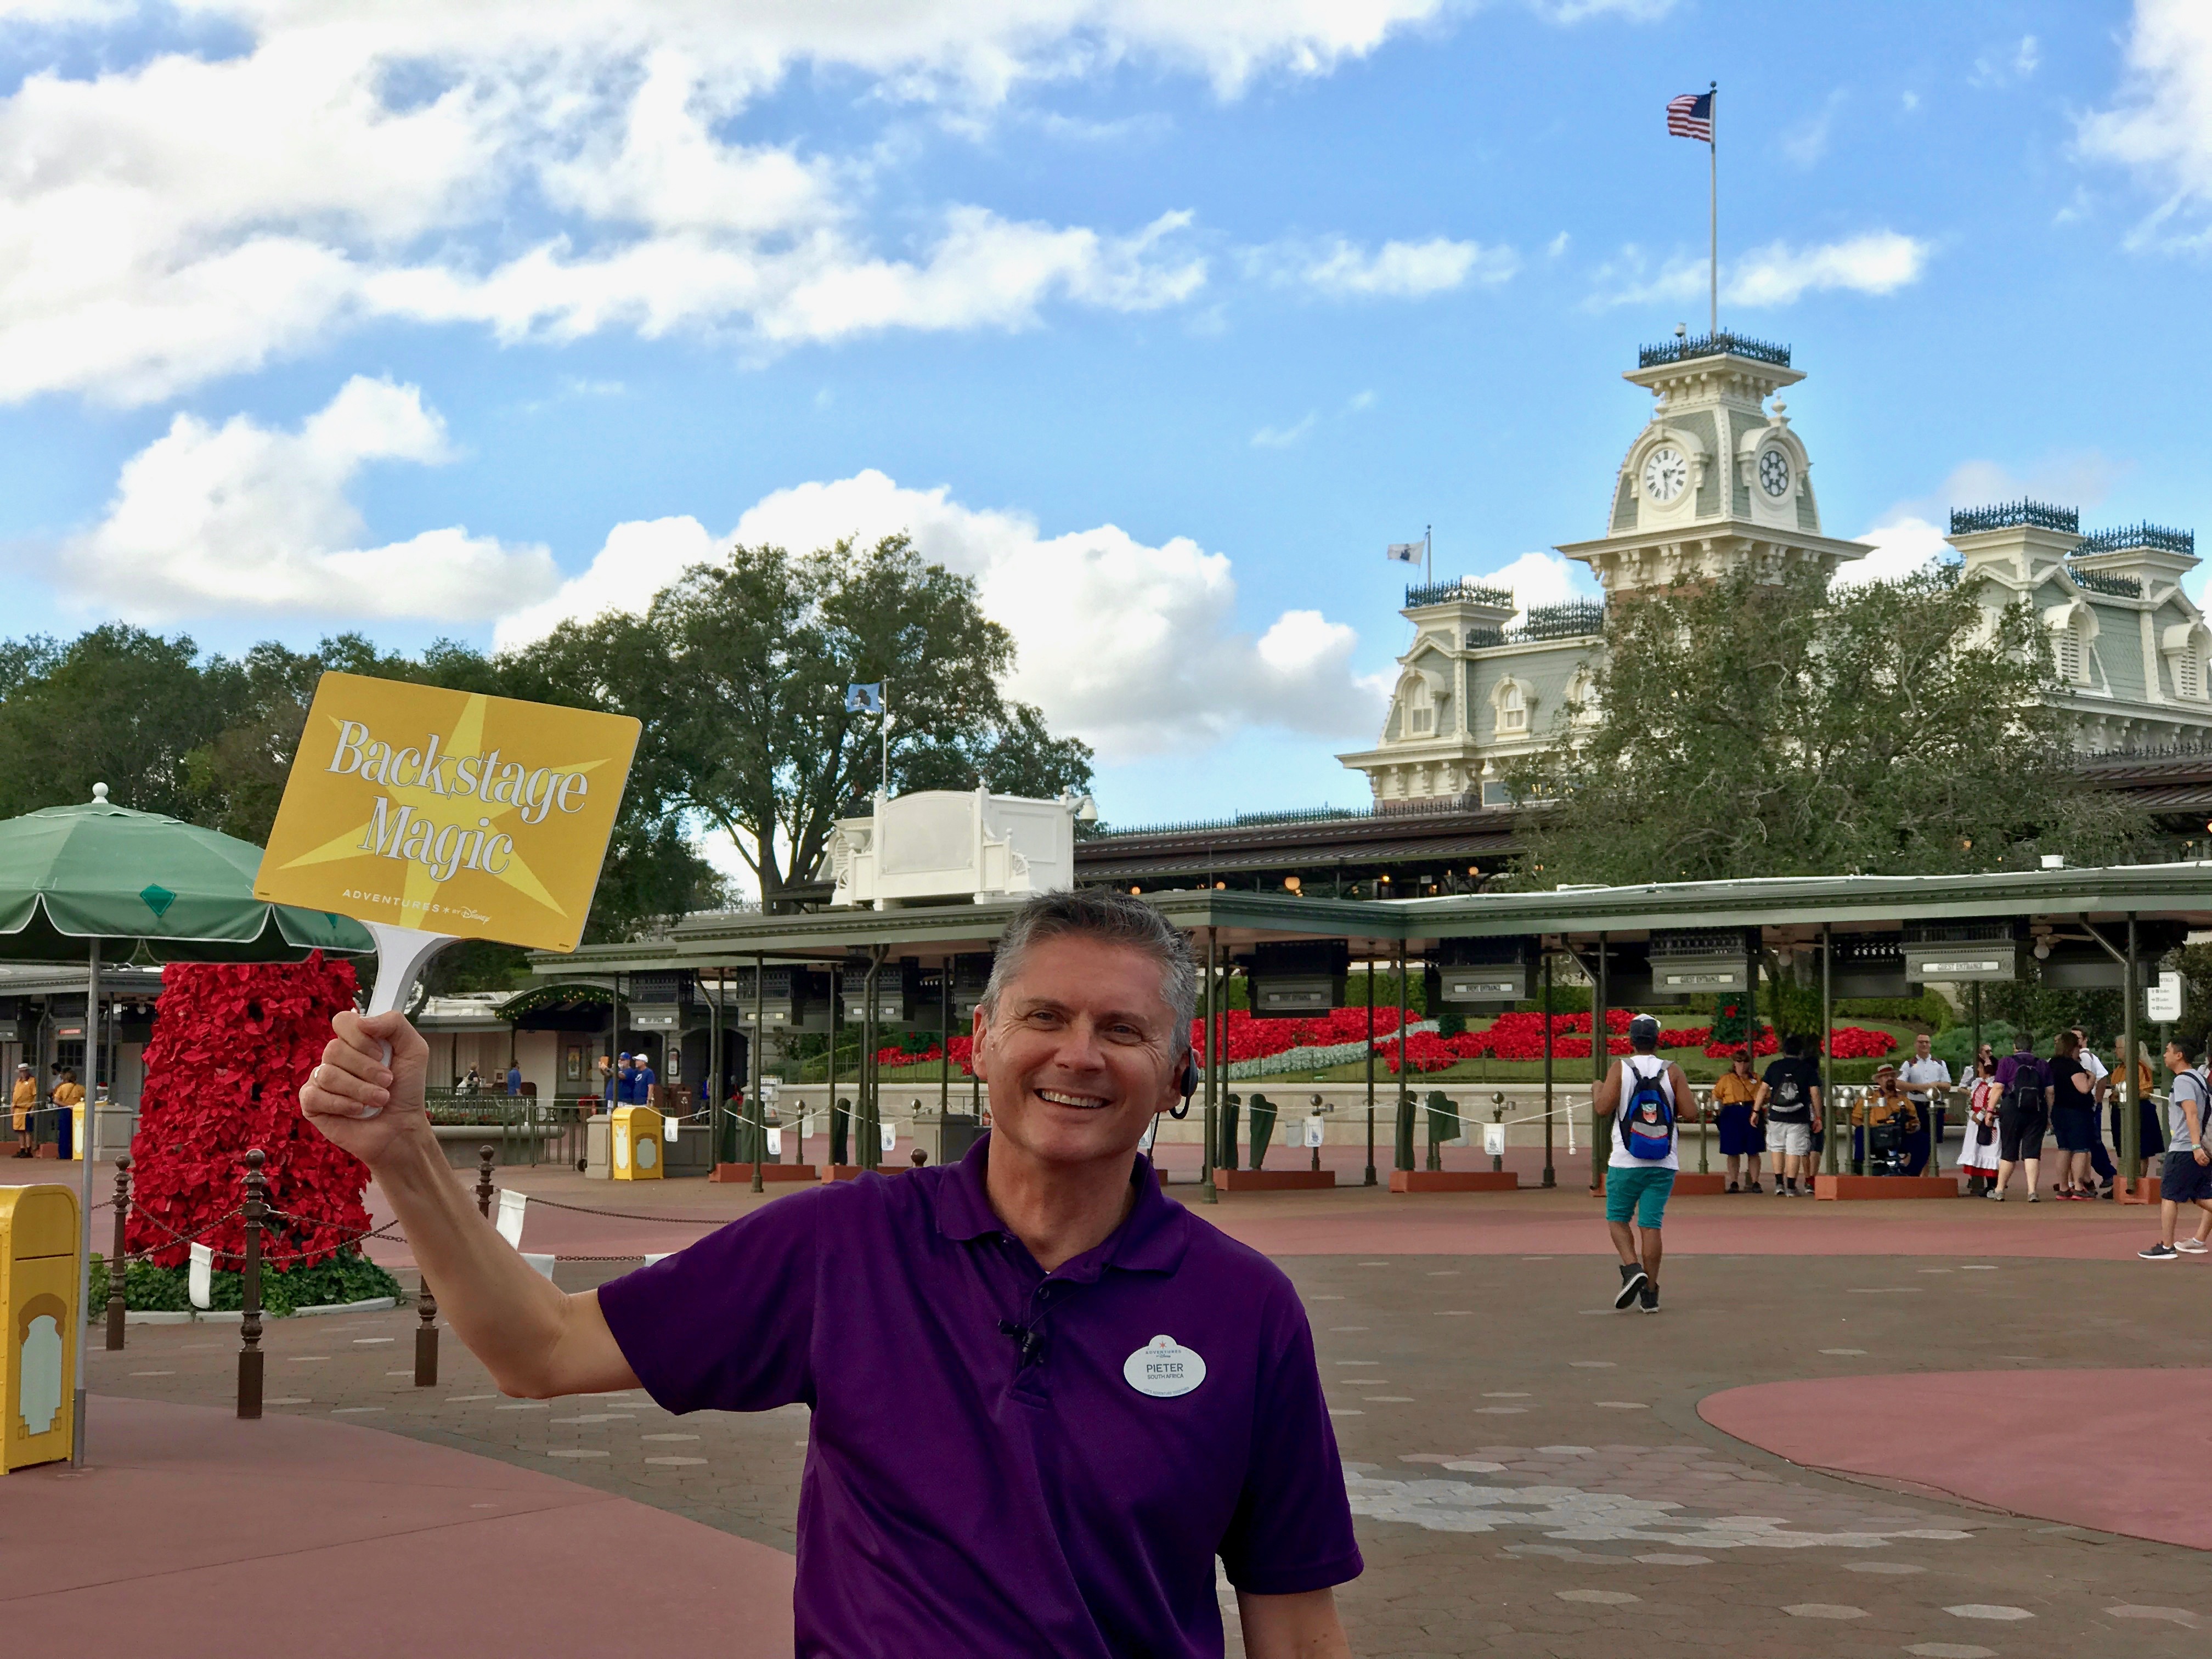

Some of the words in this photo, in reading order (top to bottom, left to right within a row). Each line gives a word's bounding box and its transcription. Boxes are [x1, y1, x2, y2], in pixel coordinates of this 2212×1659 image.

[324, 719, 589, 825] Backstage
[357, 795, 513, 882] Magic
[342, 889, 440, 913] ADVENTURES
[1147, 1363, 1183, 1373] PIETER
